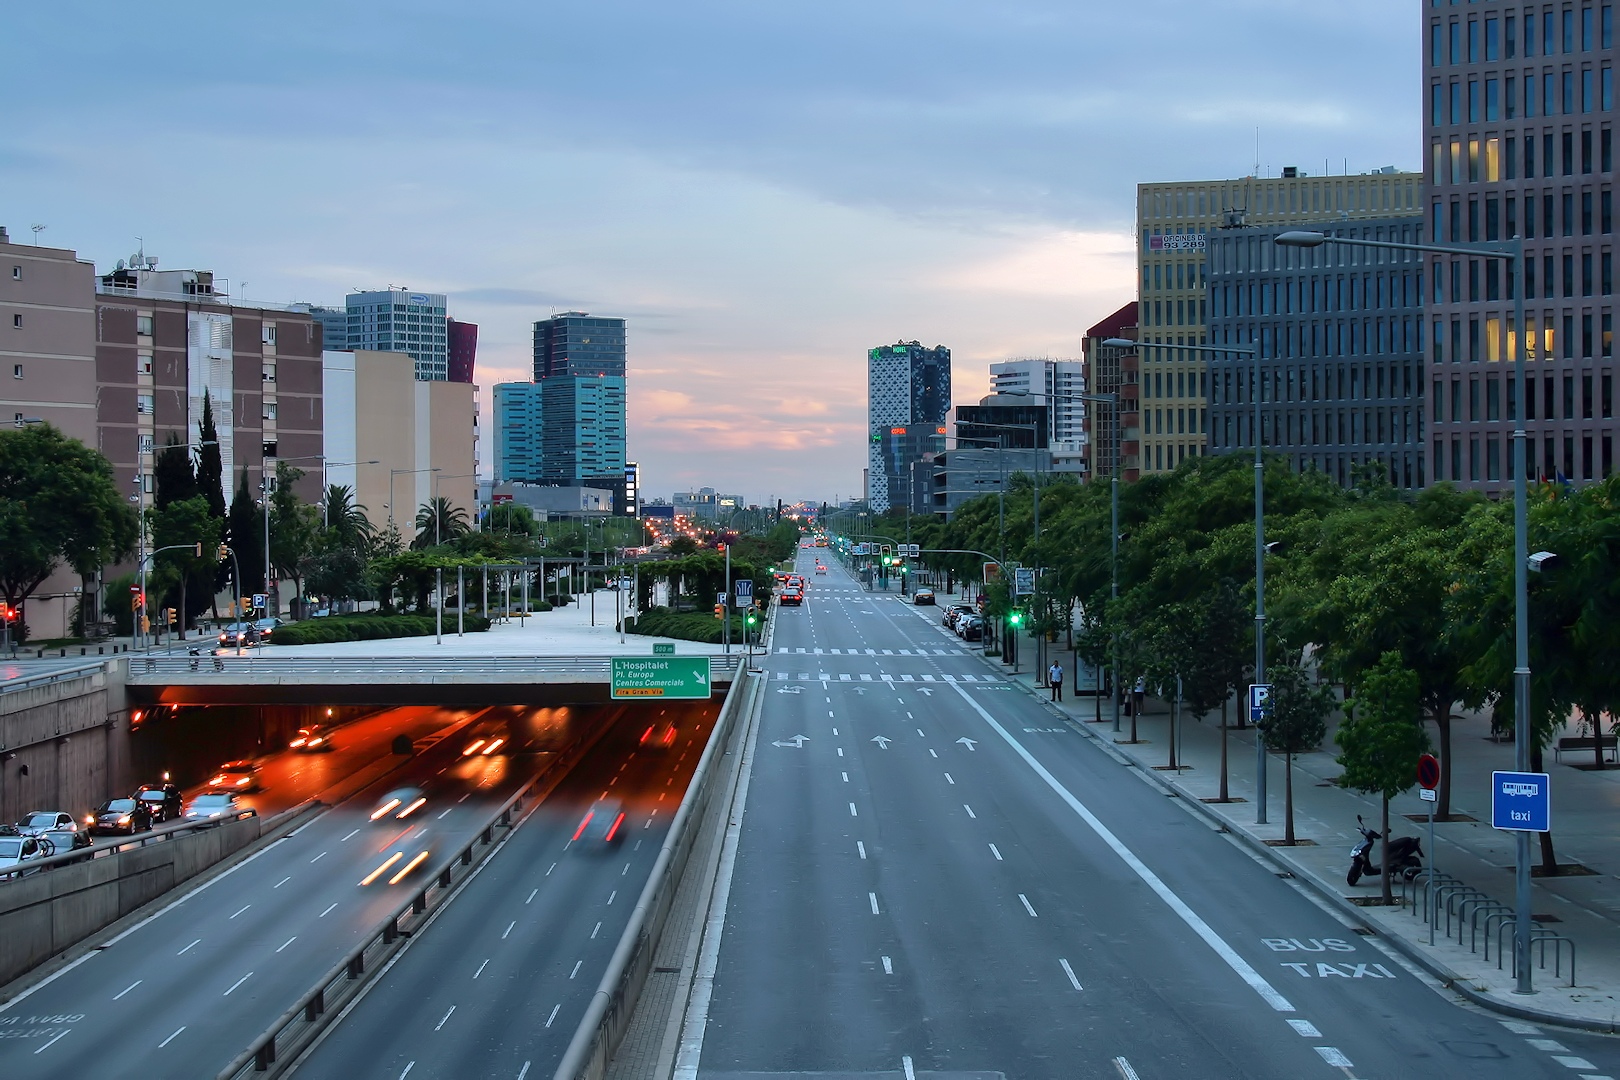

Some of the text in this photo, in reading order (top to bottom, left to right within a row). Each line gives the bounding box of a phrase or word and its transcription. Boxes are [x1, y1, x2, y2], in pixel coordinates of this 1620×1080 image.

[1183, 241, 1205, 249] 289
[628, 671, 654, 679] Europa
[1254, 687, 1269, 707] P
[1510, 810, 1531, 821] taxi
[1260, 938, 1356, 952] BUS
[1280, 962, 1396, 978] TAXI
